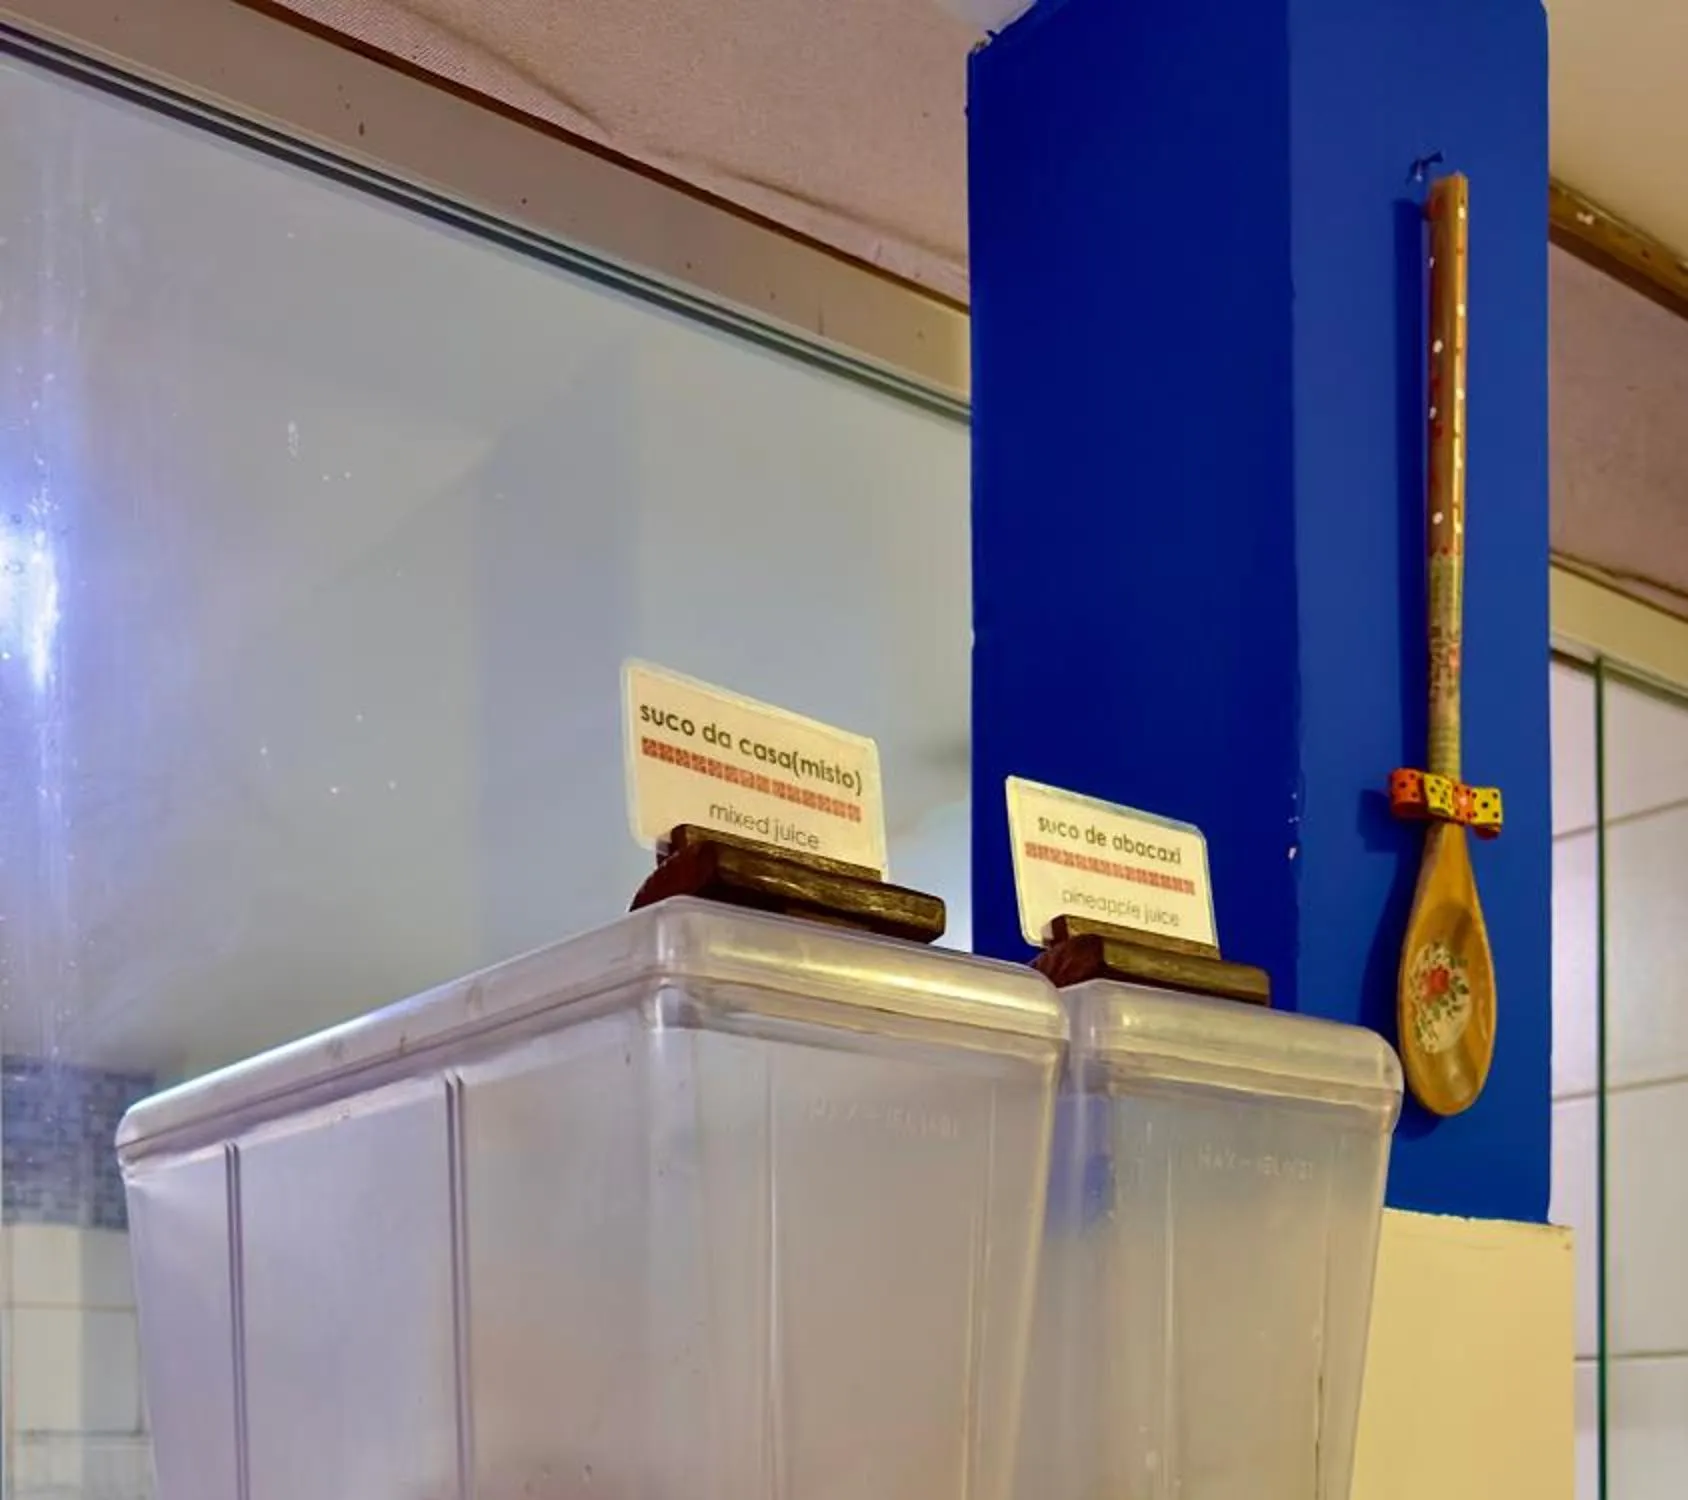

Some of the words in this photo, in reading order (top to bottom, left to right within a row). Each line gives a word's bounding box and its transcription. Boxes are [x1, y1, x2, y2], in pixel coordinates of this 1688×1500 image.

[640, 704, 695, 736] suco
[702, 723, 731, 750] da
[739, 738, 862, 797] casa(misto)
[709, 801, 769, 834] mixed
[773, 816, 820, 850] juice
[1037, 816, 1080, 840] suco
[1085, 826, 1108, 847] de
[1112, 833, 1182, 865] abacaxi
[1061, 889, 1142, 919] pineapple
[1144, 902, 1180, 927] juice
